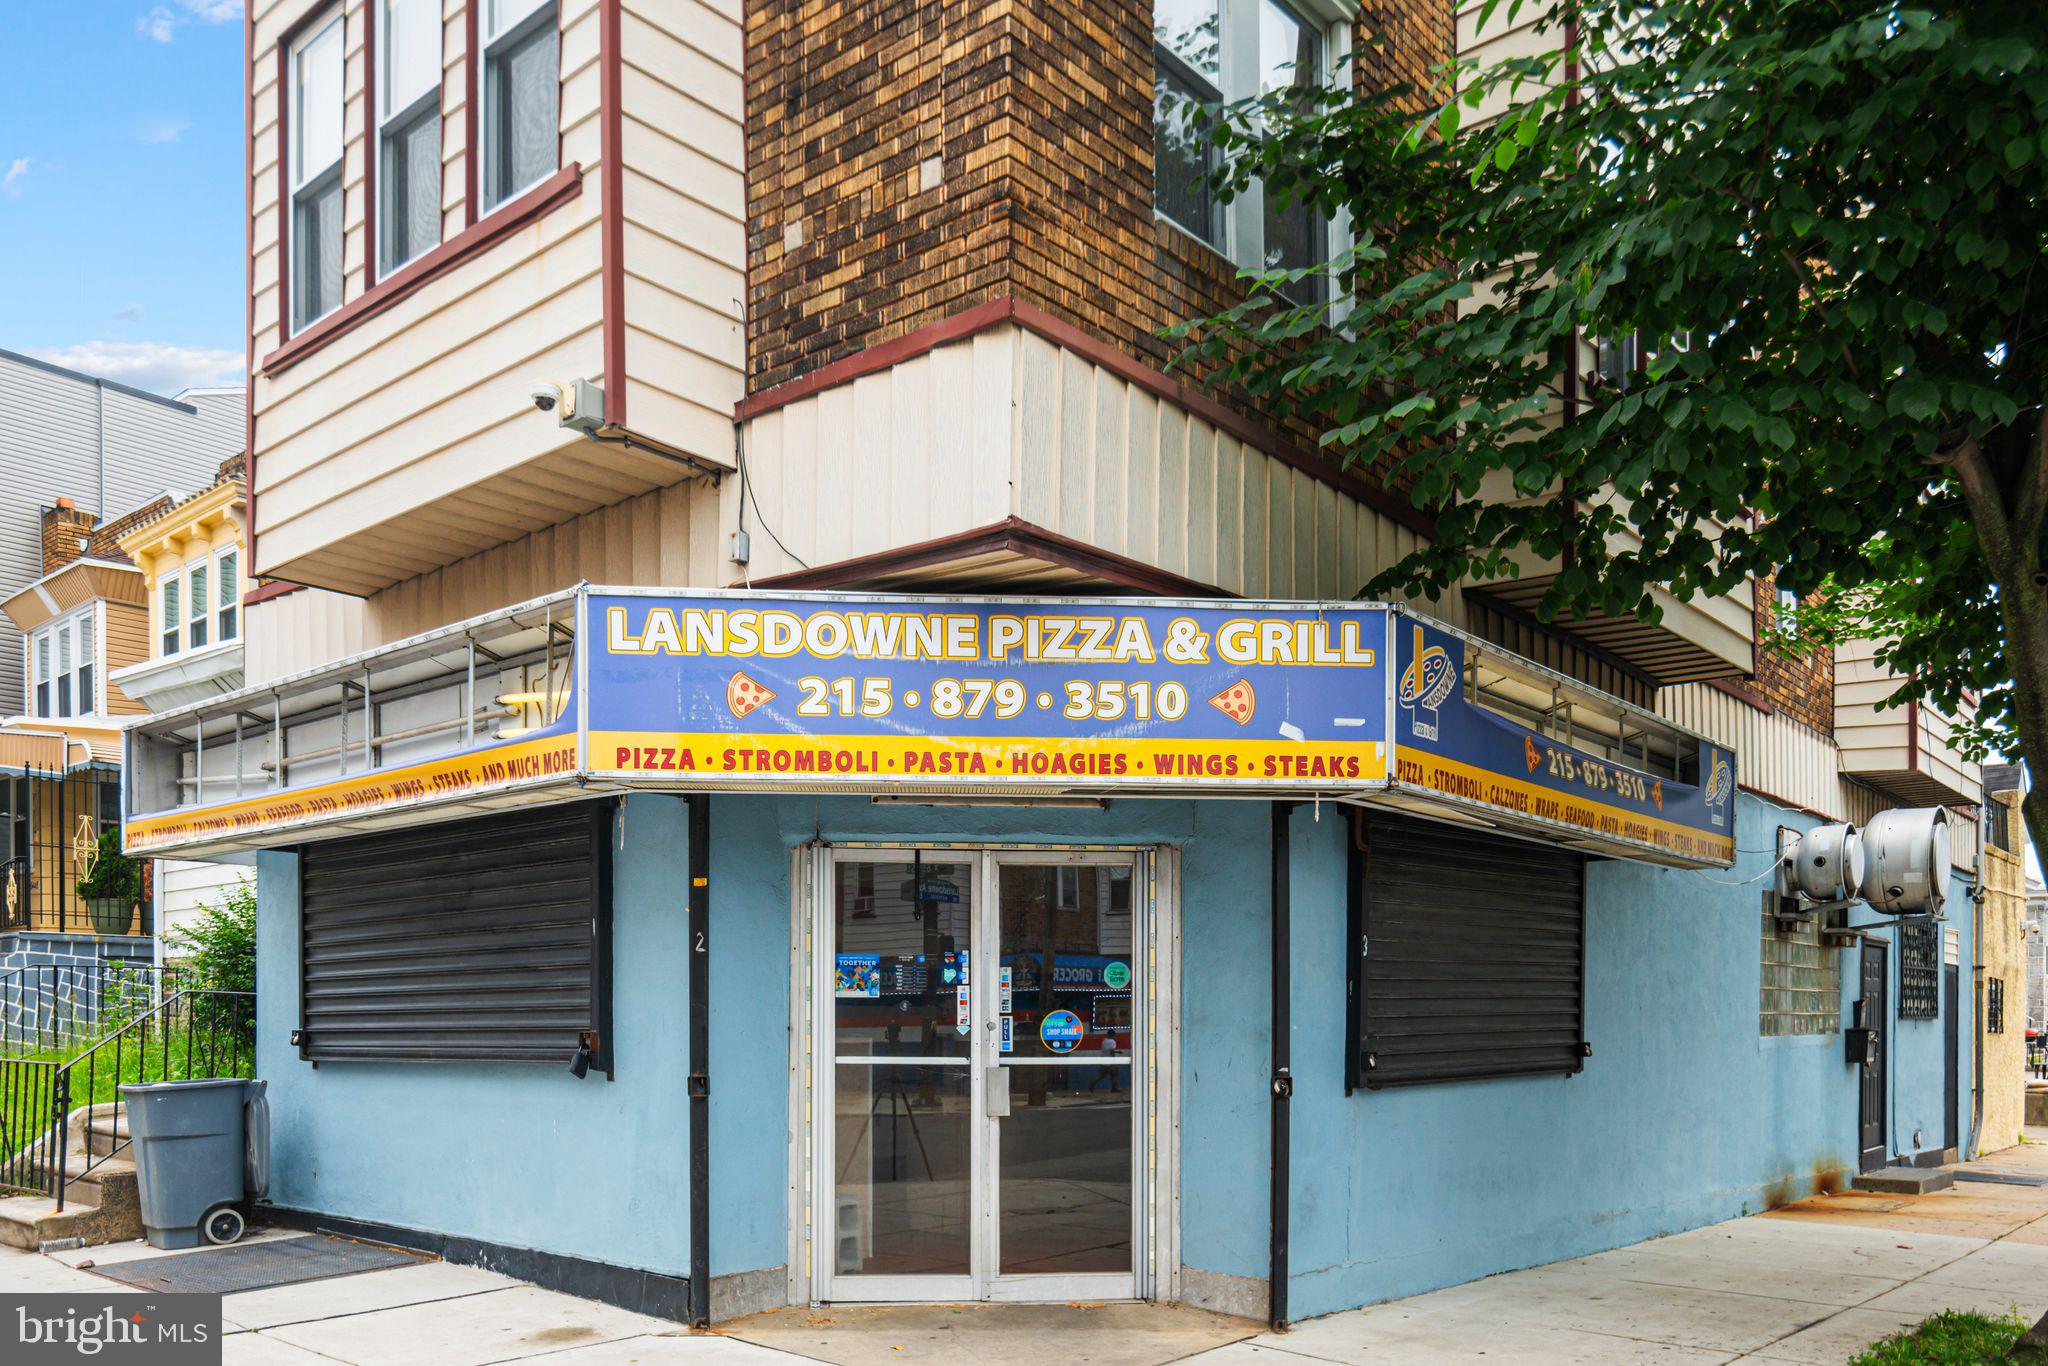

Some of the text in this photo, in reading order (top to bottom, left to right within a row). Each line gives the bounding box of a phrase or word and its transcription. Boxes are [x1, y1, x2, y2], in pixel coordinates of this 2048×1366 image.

[606, 606, 1375, 667] LANSDOWNE PIZZA & GRILL
[797, 676, 1188, 721] 215 879 3510
[265, 802, 305, 823] SEAFOOD
[308, 796, 338, 816] PASTA
[343, 787, 385, 810] HOAGIES
[390, 778, 425, 801] WINGS
[432, 768, 472, 792] STEAKS
[482, 763, 504, 786] AND
[507, 754, 539, 779] MUCH
[543, 747, 575, 773] MORE
[616, 747, 1360, 778] PIZZA STROMBOLI PASTA HOAGIES WINGS STEAKS
[1547, 746, 1646, 803] 215 879 3510
[1397, 758, 1424, 785] PIZZA
[1434, 768, 1482, 801] STROMBOLI
[1490, 784, 1528, 811] CALZONES
[1535, 797, 1559, 820] WRAPS
[1565, 805, 1595, 829] SEAFOOD
[1600, 814, 1619, 833] PASTA
[1624, 820, 1648, 842] HOAGIES
[695, 931, 706, 952] 2
[839, 959, 877, 967] TOGETHER
